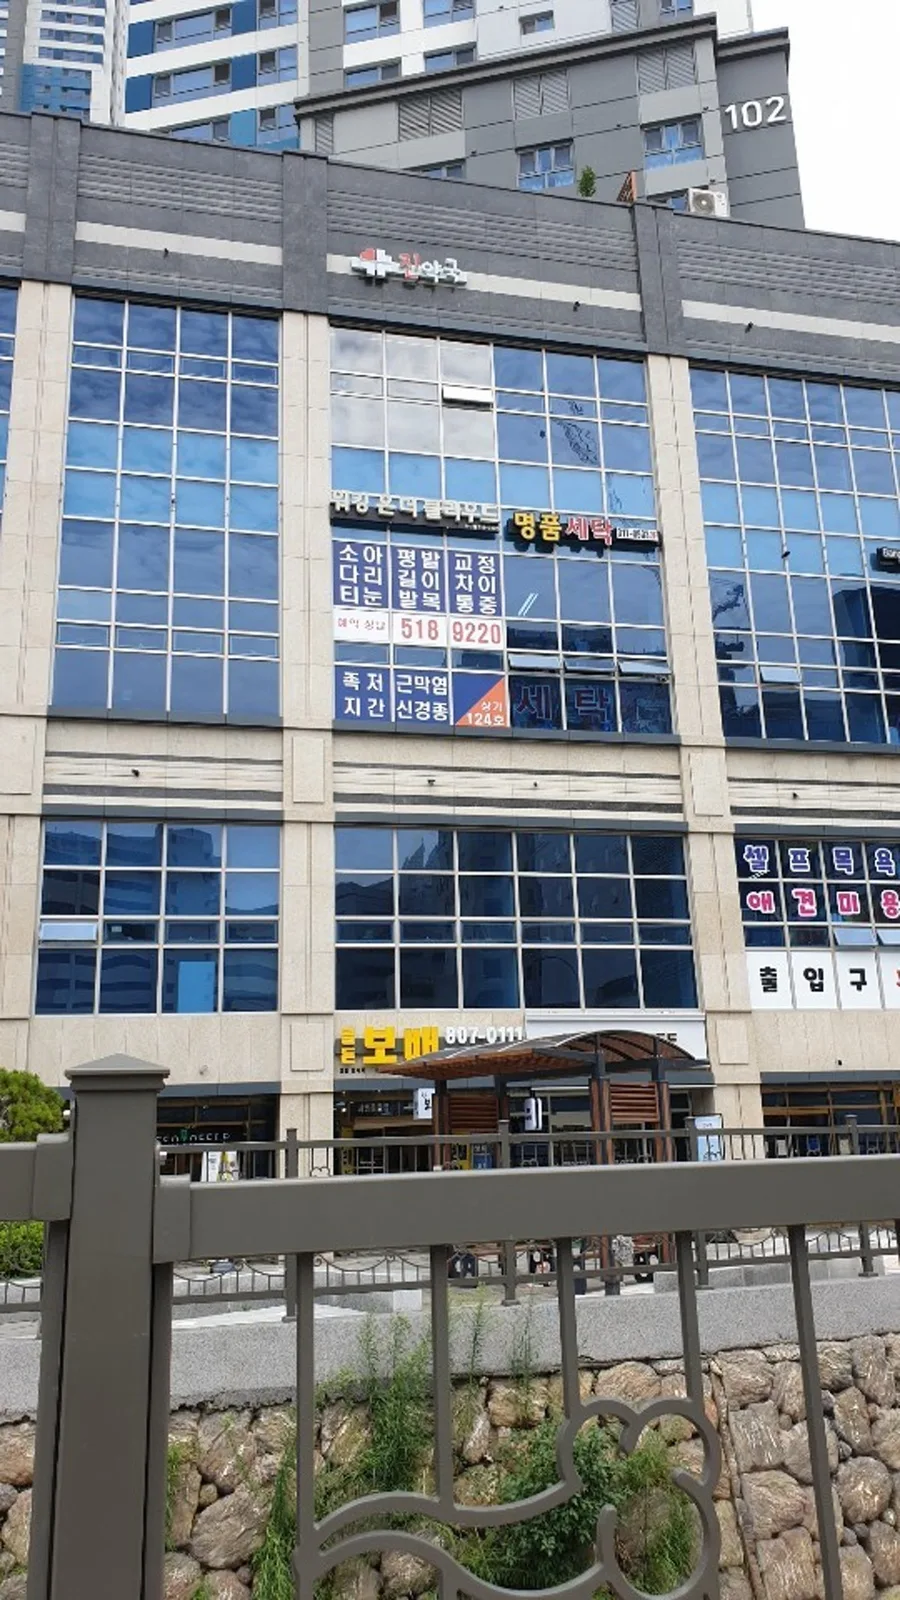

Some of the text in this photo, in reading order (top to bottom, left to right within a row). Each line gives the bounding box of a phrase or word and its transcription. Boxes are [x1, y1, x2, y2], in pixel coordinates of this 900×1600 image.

[724, 96, 787, 129] 102
[339, 544, 496, 574] 소아 평발 교정
[339, 564, 496, 595] 다리 길이 차이
[340, 585, 383, 606] 티눈
[398, 589, 441, 611] 발목
[400, 618, 439, 641] 518
[452, 621, 501, 645] 9220
[343, 671, 448, 696] 족저 근막염
[344, 697, 449, 722] 지간 신경종
[468, 712, 505, 726] 124호
[444, 1026, 523, 1045] 807-0111
